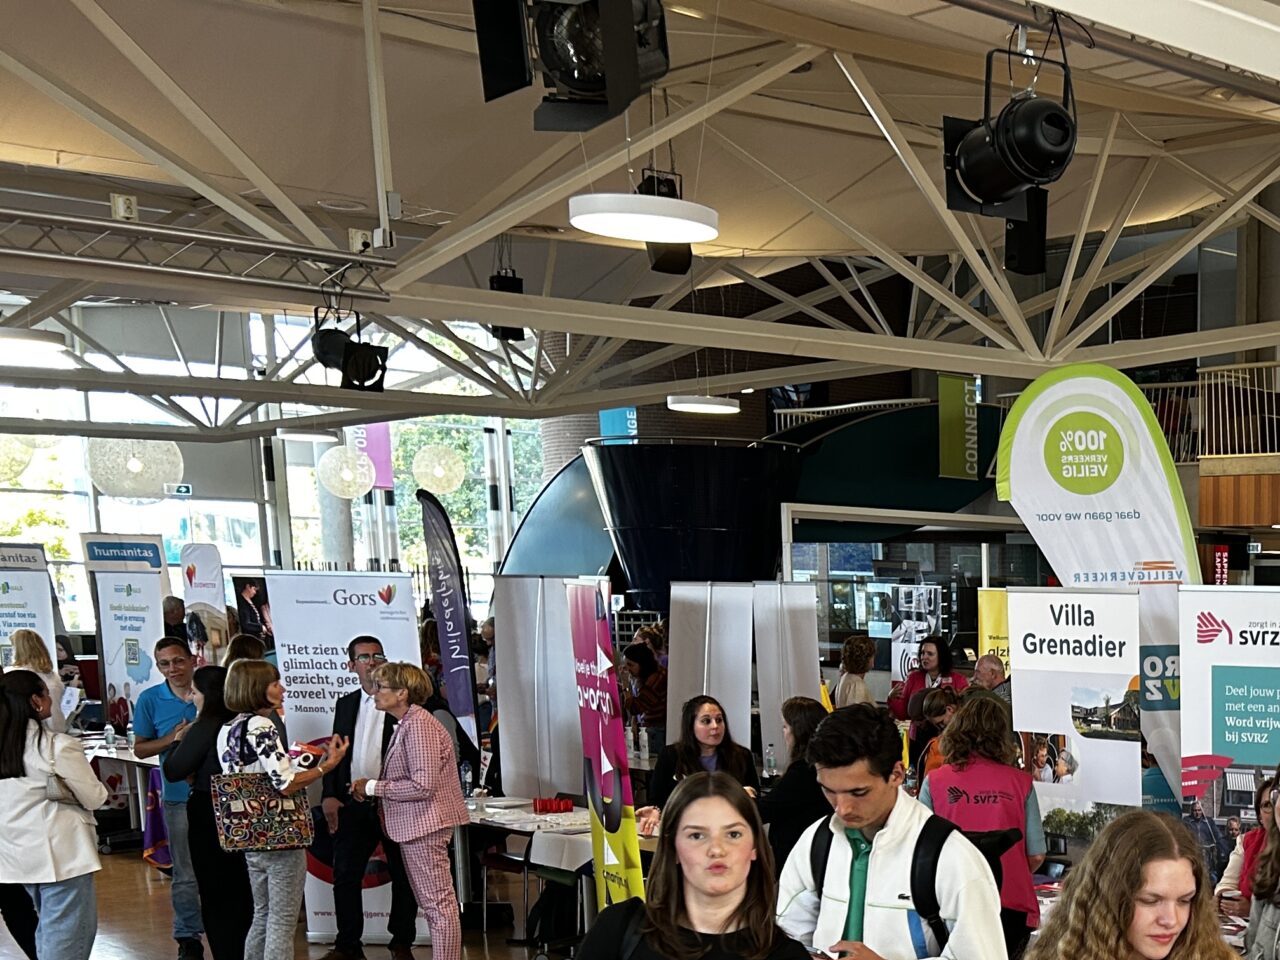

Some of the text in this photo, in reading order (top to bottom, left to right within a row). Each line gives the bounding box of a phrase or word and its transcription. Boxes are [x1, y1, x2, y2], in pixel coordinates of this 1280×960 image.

[964, 381, 978, 475] CONNECT
[0, 553, 37, 563] anitas
[93, 546, 154, 558] humanitas
[333, 589, 377, 606] Gors
[1049, 603, 1095, 627] Villa
[1248, 620, 1268, 629] zorgt
[312, 644, 339, 655] zien
[1022, 632, 1126, 657] Grenadier
[283, 657, 337, 672] glimlach
[285, 673, 334, 687] gezicht,
[287, 688, 326, 699] zoveel
[1225, 685, 1248, 696] Deel
[1249, 686, 1275, 699] jouw
[294, 704, 328, 714] Manon,
[1225, 702, 1245, 712] met
[1247, 703, 1265, 712] een
[1225, 716, 1254, 728] Word
[1225, 731, 1269, 744] bij SVRZ
